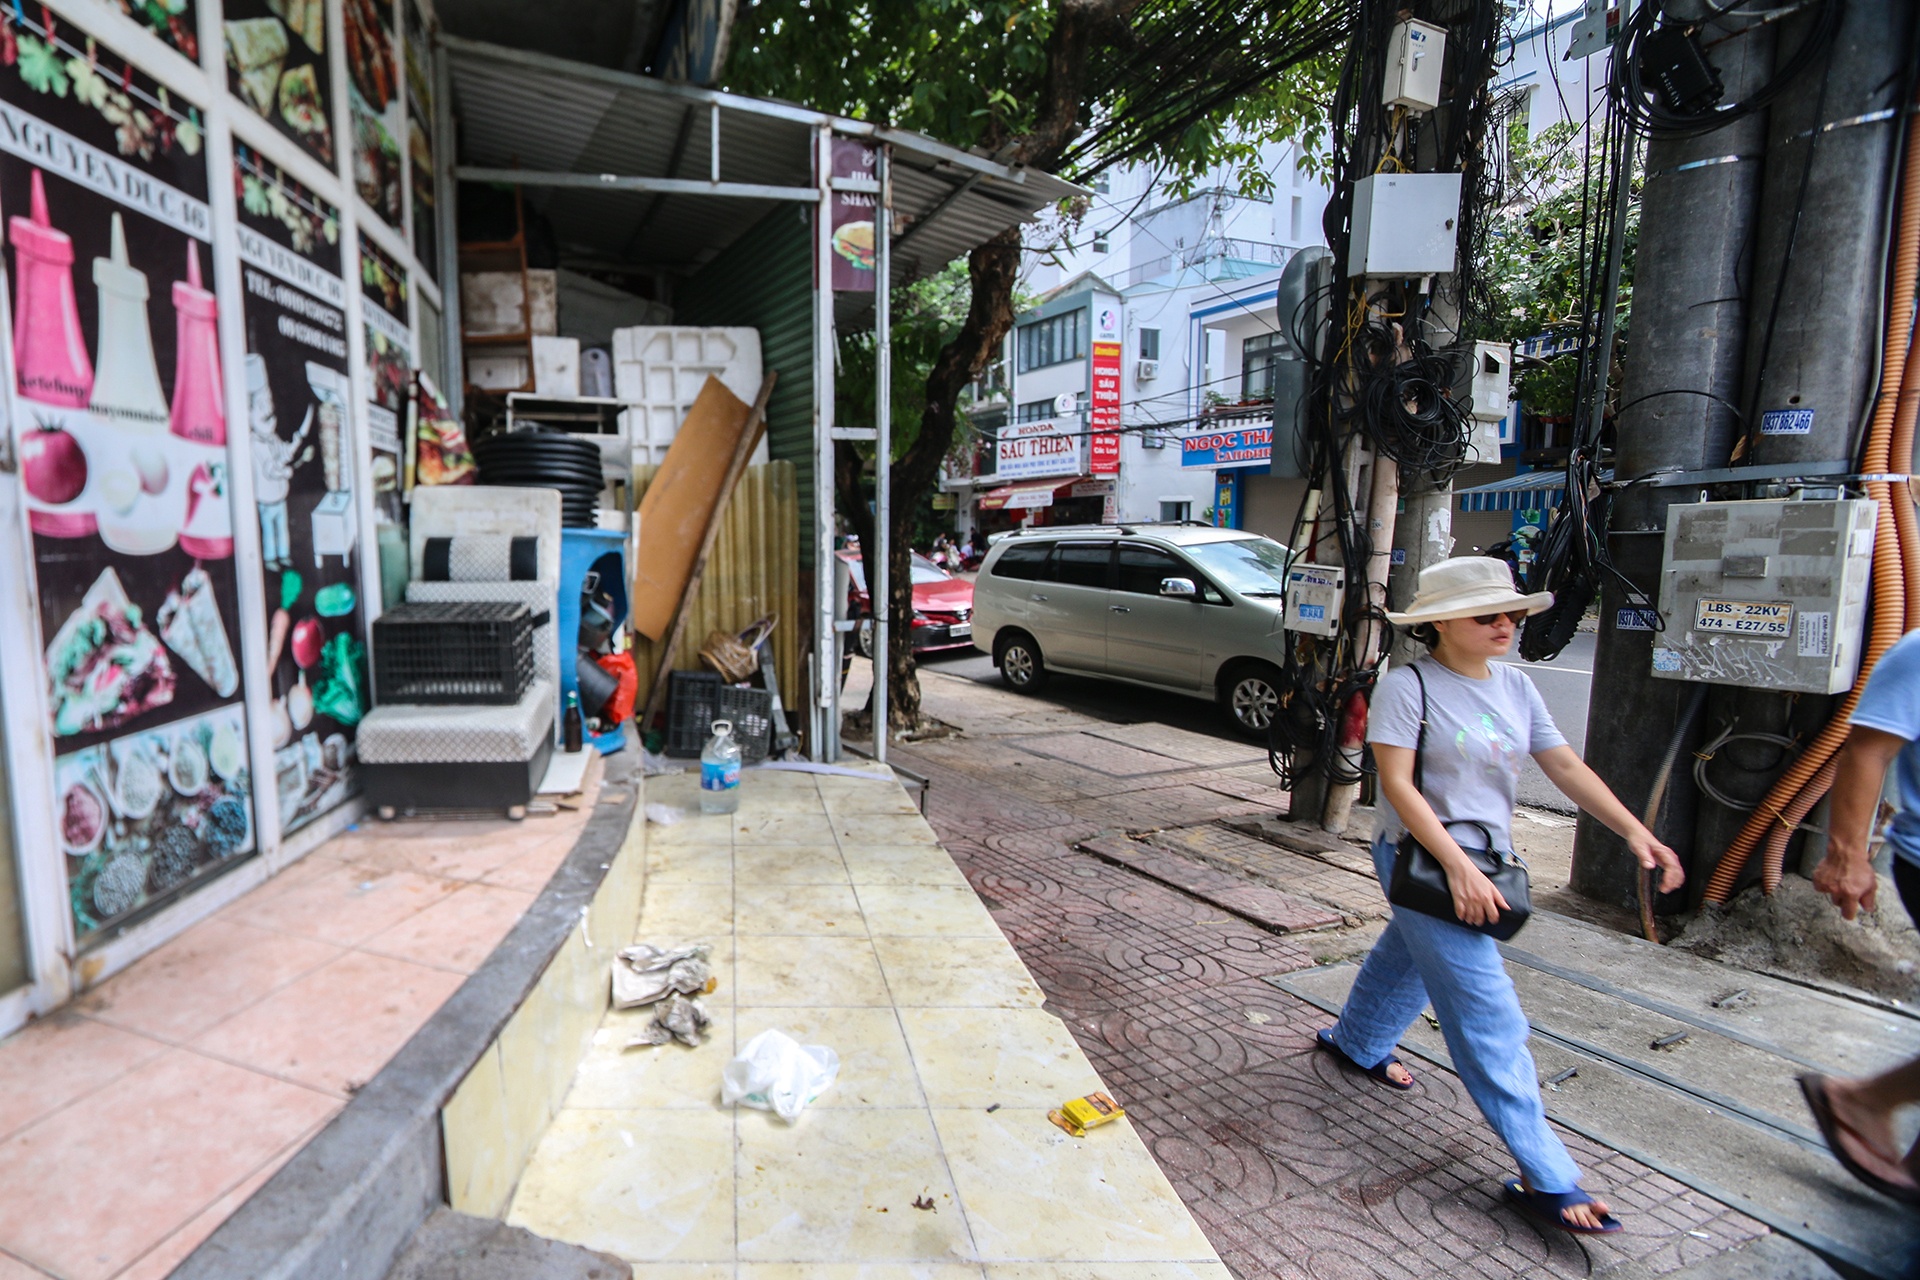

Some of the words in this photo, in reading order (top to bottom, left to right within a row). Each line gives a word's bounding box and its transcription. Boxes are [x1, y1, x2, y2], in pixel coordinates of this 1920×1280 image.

[841, 193, 877, 207] SHA
[1018, 423, 1054, 435] HONDA
[1184, 433, 1237, 453] NGỌC
[1708, 603, 1732, 613] LBS
[1745, 605, 1780, 616] 22KV
[1699, 618, 1723, 627] 474
[1736, 620, 1785, 632] E27/55
